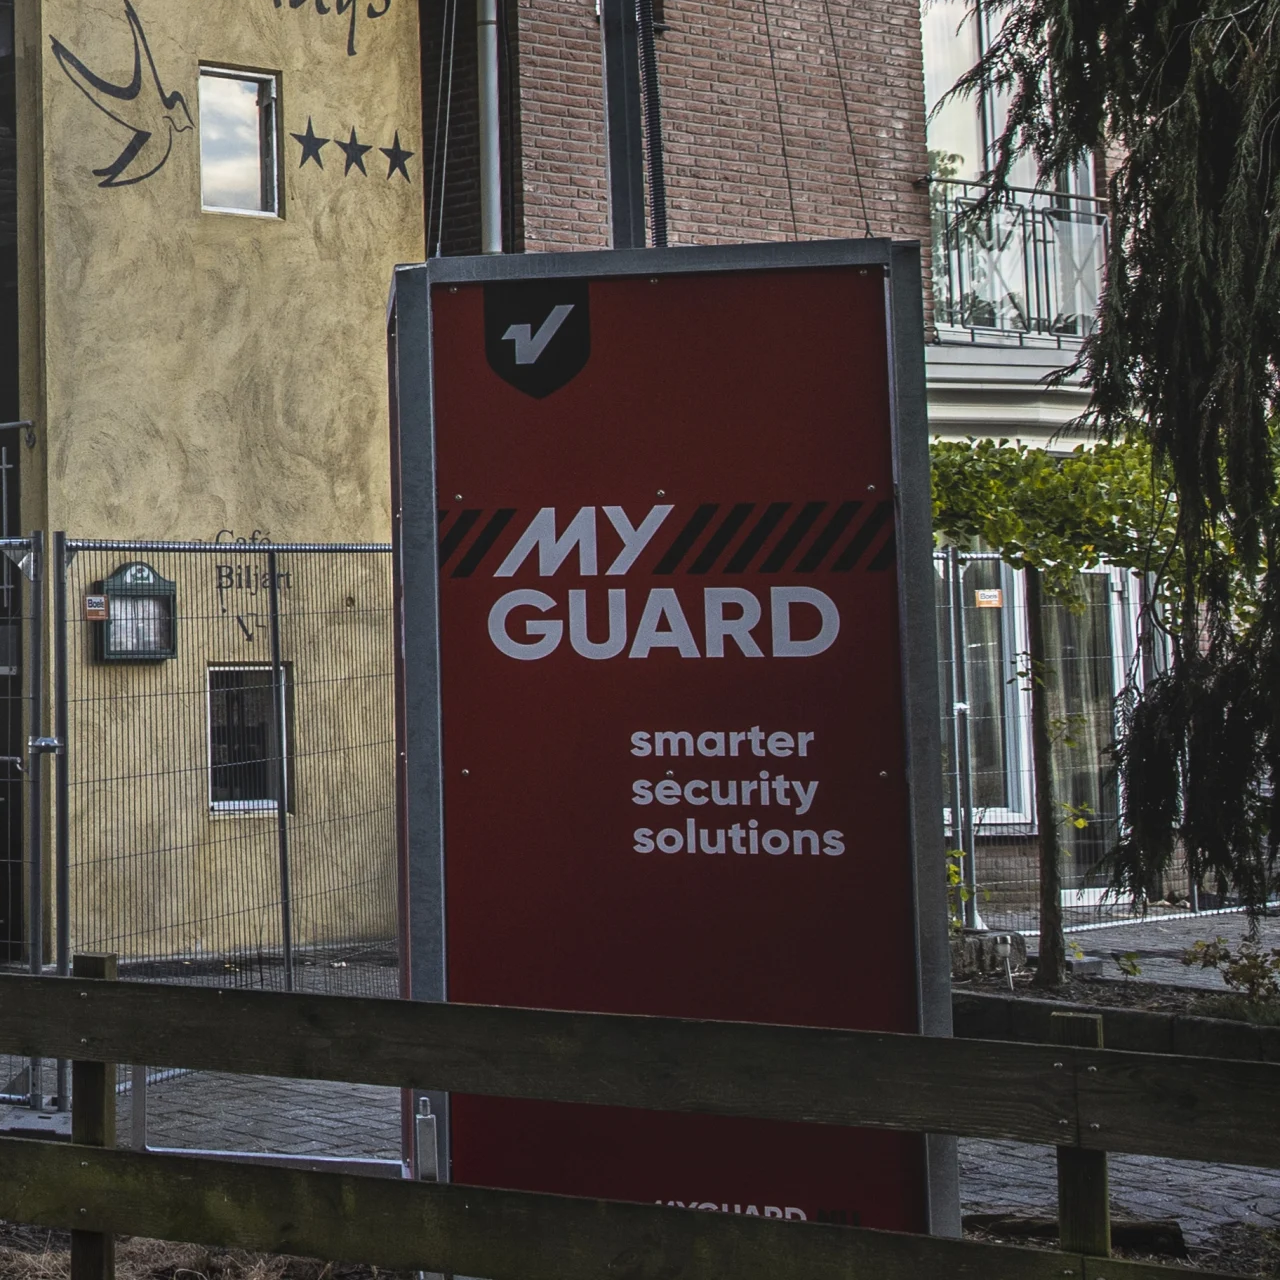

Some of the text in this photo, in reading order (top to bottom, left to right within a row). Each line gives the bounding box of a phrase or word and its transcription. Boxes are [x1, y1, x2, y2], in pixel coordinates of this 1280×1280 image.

[493, 504, 675, 577] MY
[487, 586, 840, 660] GUARD
[630, 725, 814, 757] smarter
[631, 771, 819, 815] security
[633, 818, 845, 856] solutions
